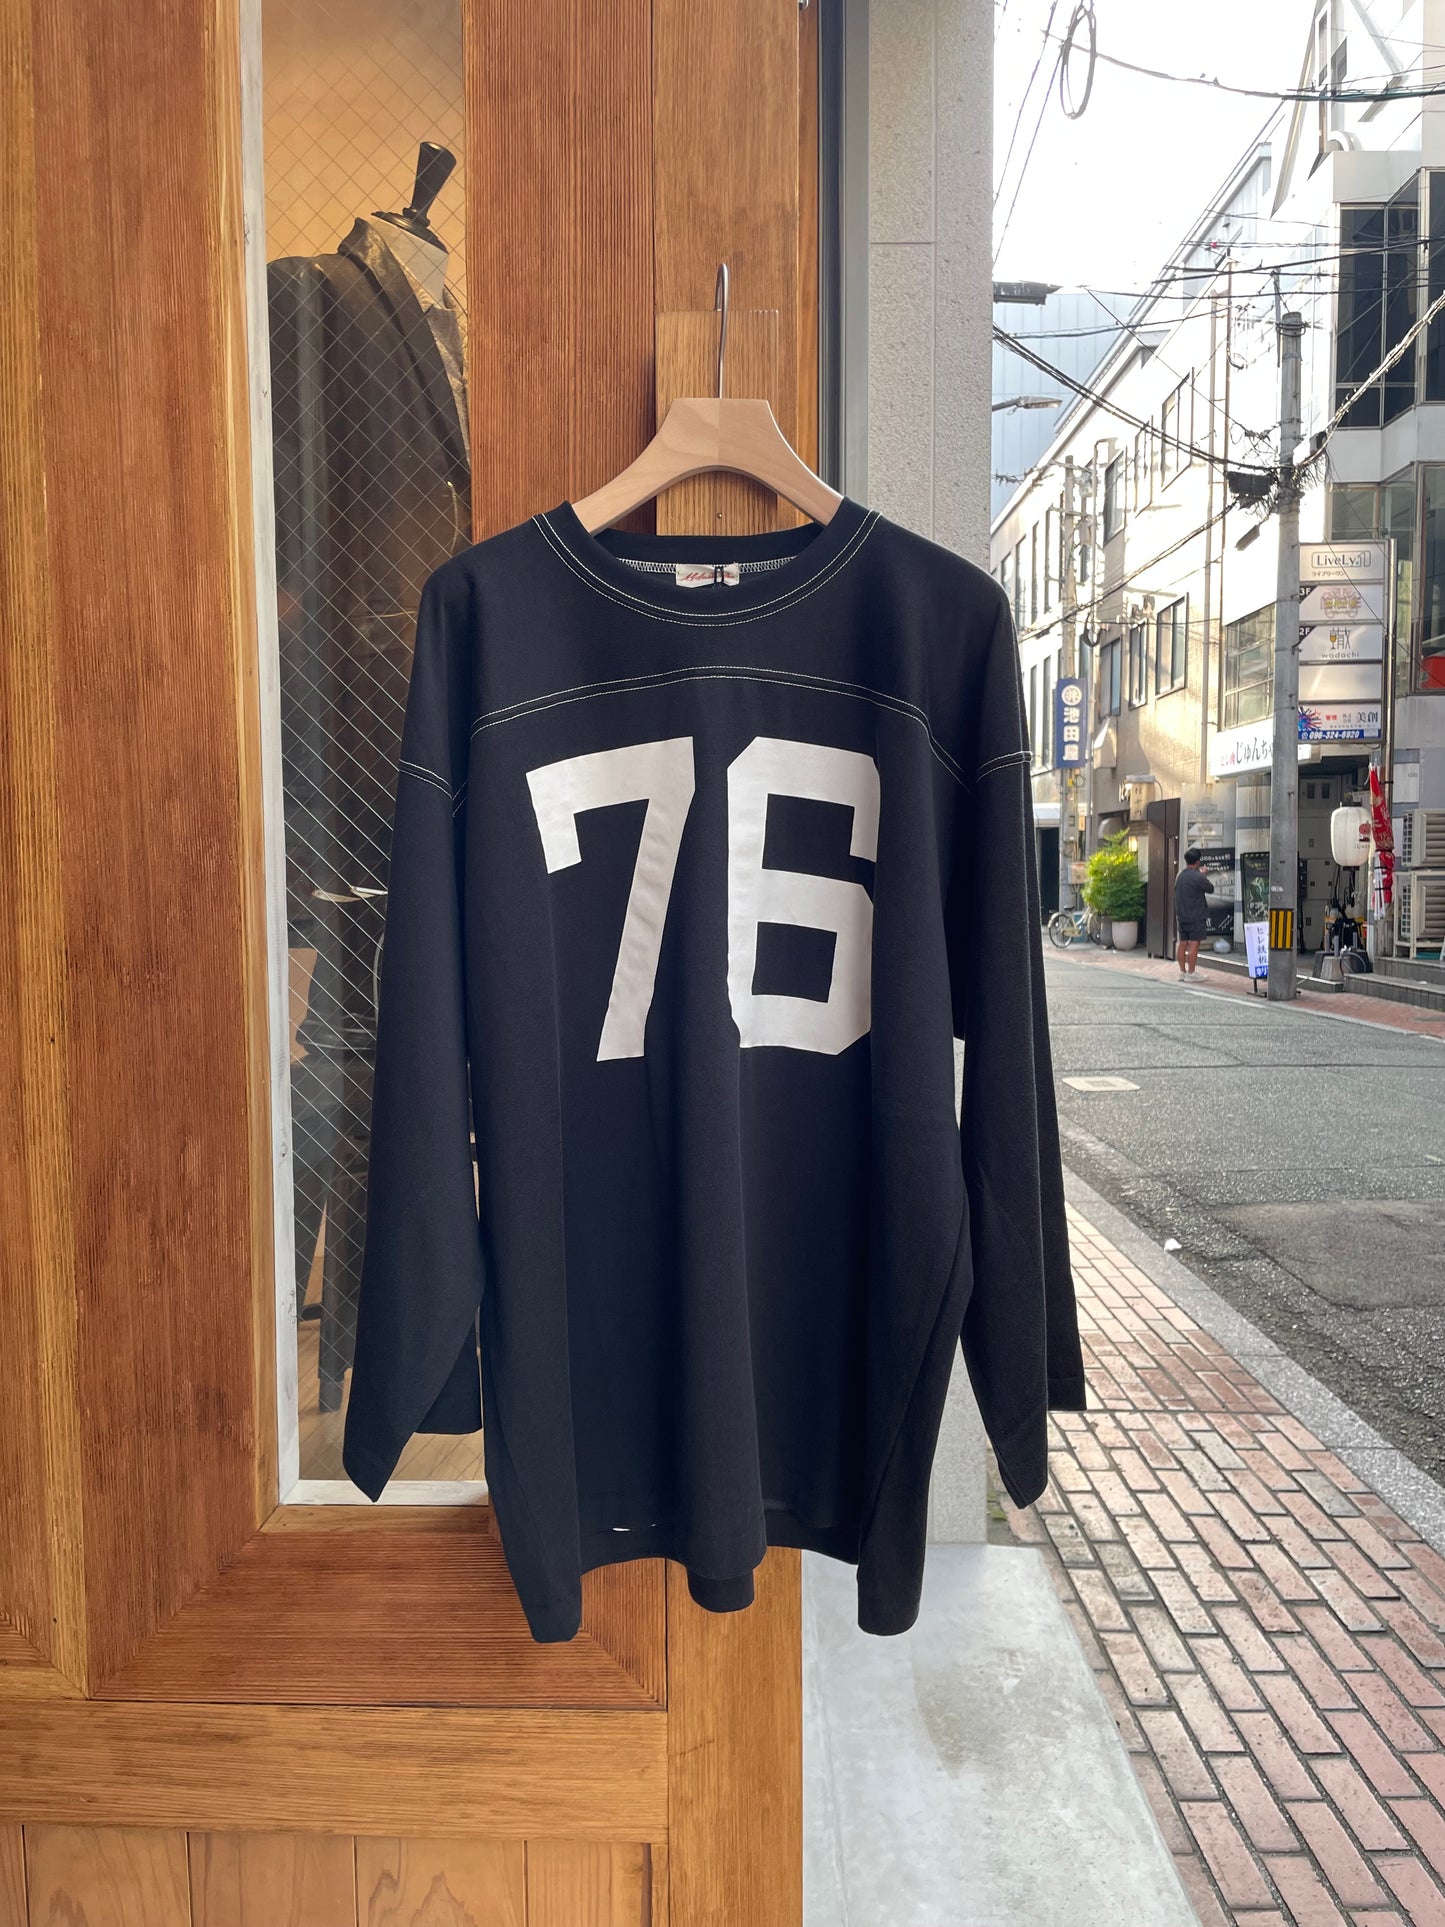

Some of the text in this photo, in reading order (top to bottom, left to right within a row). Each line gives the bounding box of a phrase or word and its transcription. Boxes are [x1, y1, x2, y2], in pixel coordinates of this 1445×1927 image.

[1299, 587, 1311, 596] 3F
[1299, 627, 1311, 636] 2F
[1321, 651, 1360, 659] wadachi
[526, 737, 881, 1061] 76
